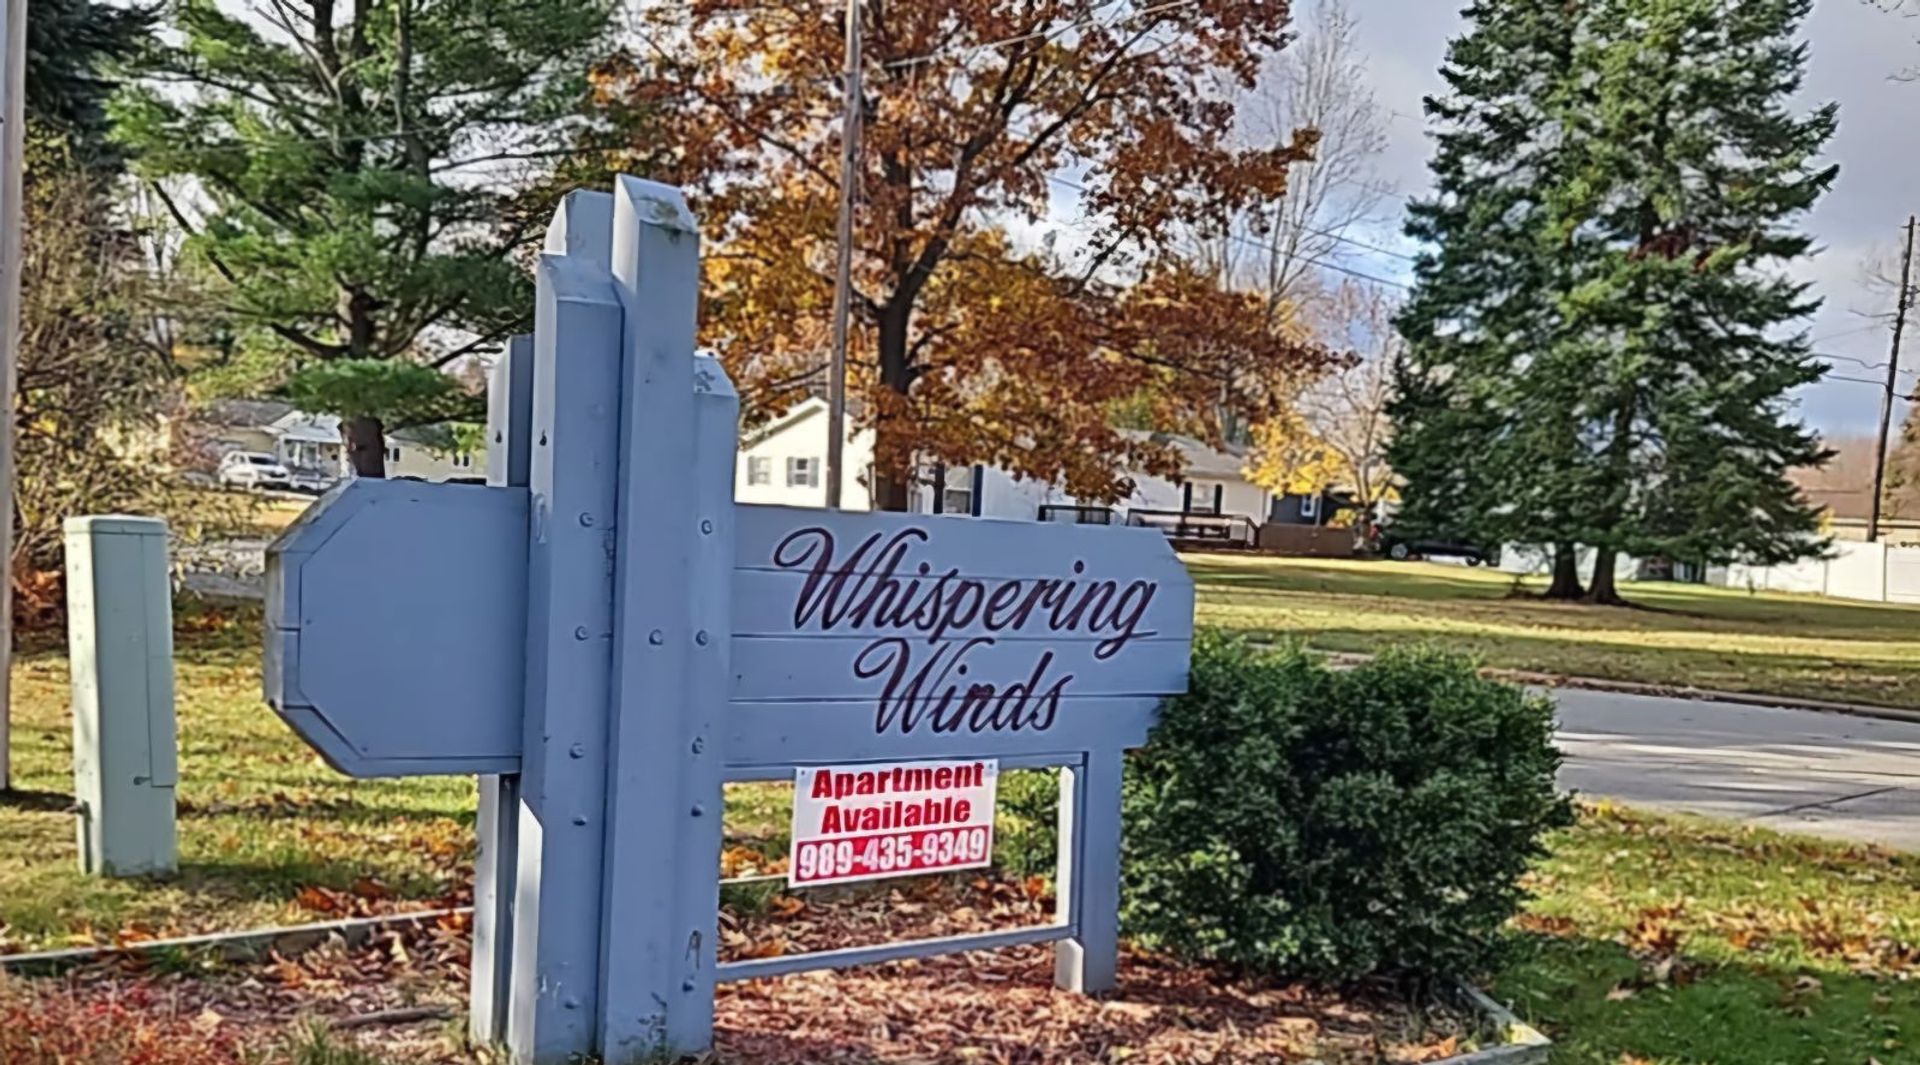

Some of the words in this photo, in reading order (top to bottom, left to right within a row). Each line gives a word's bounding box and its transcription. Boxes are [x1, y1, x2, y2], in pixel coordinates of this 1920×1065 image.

[773, 527, 1158, 660] Whispering
[853, 636, 1074, 734] Winds
[811, 762, 985, 800] Apartment
[821, 796, 971, 834] Available
[799, 828, 985, 880] 989-435-9349
